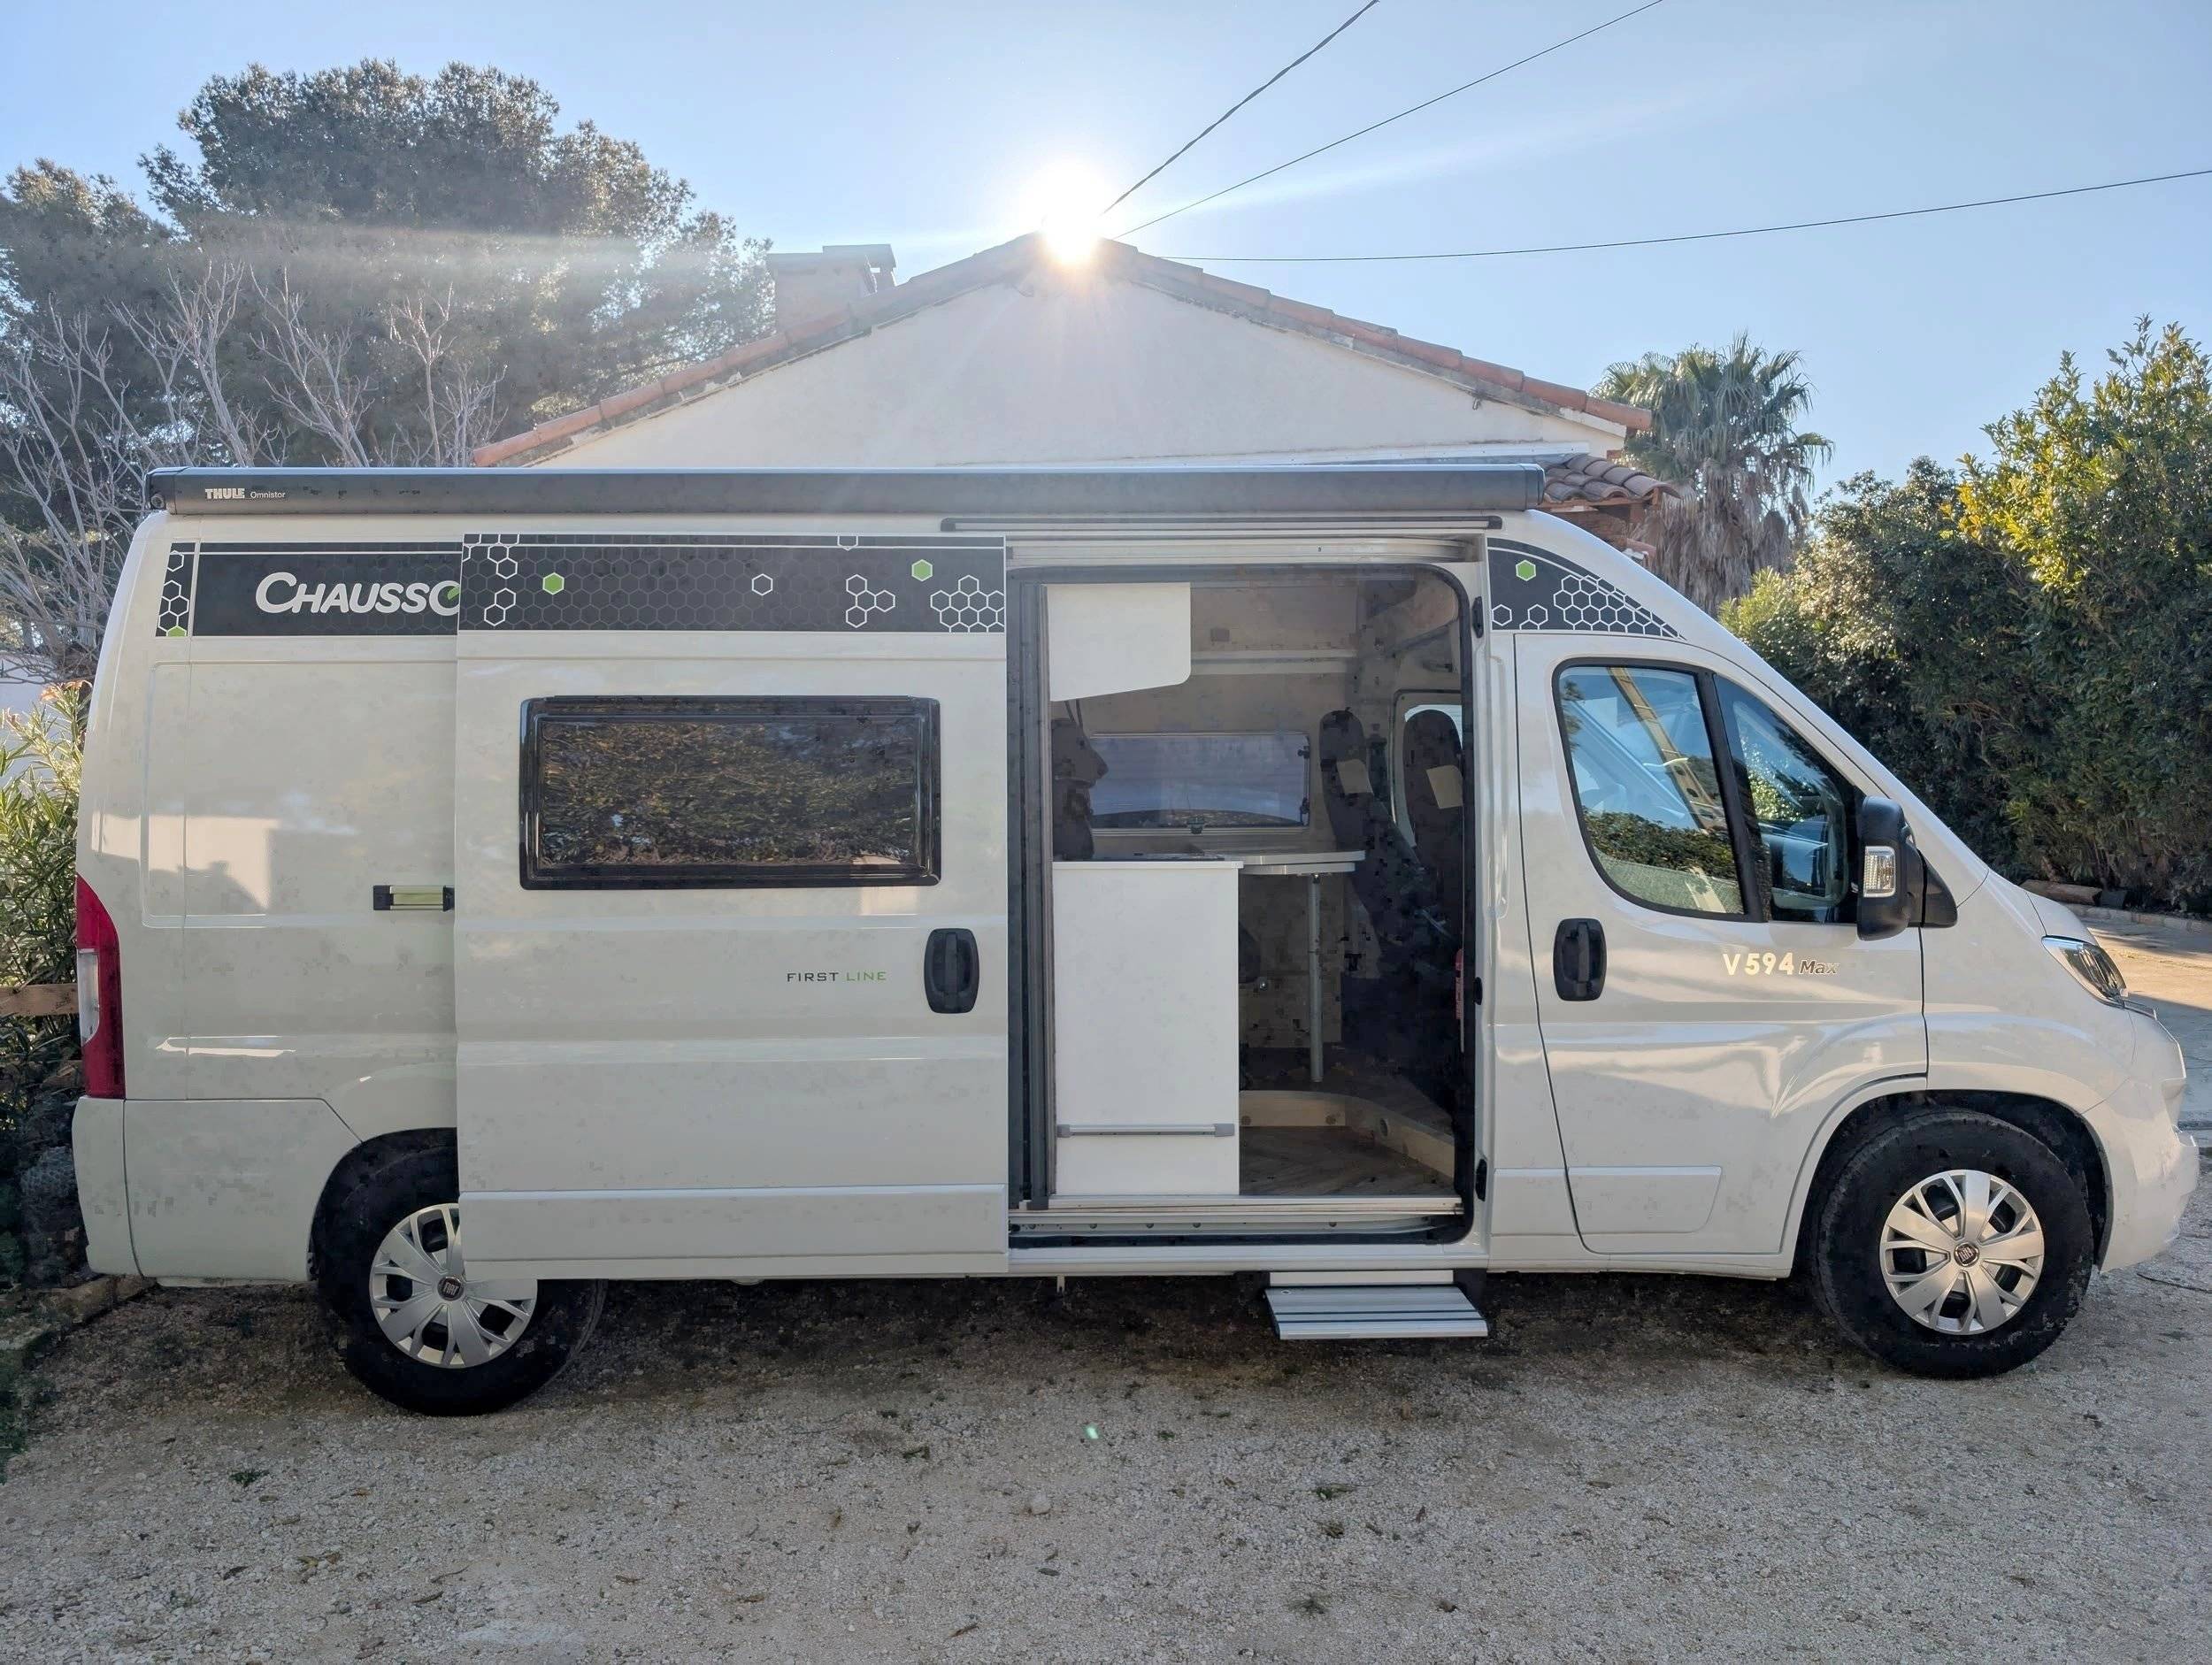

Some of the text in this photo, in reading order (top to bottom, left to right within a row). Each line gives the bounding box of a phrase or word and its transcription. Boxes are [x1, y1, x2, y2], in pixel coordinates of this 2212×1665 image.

[205, 488, 245, 500] THULE
[1799, 960, 1840, 975] Max
[787, 971, 887, 982] FIRST LINE
